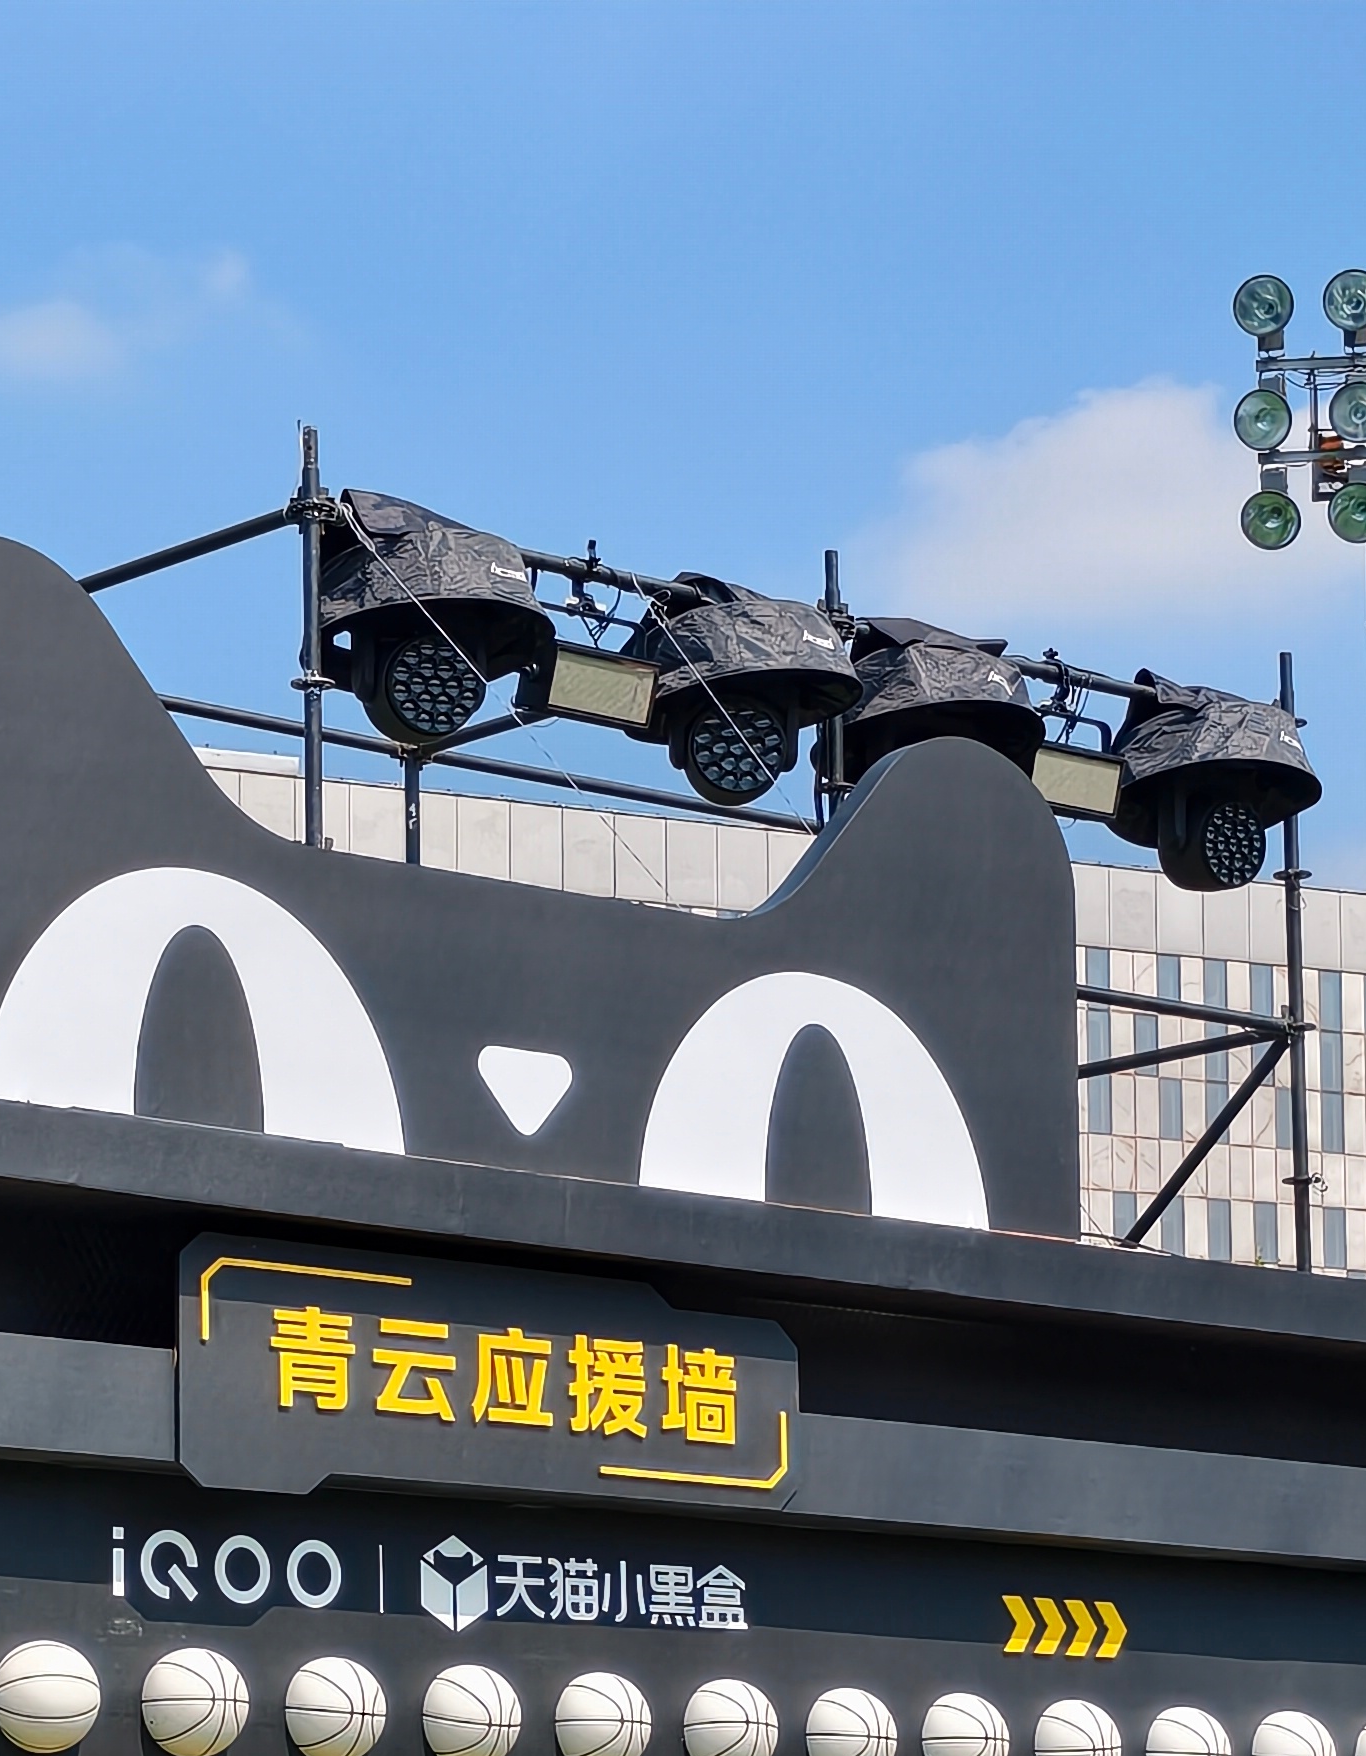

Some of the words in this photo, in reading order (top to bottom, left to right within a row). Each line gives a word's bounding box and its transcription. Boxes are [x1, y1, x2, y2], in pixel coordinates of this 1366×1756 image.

[269, 1305, 737, 1446] 青云应援墙
[111, 1525, 343, 1610] iQOO
[493, 1552, 750, 1632] 天猫小黑盒
